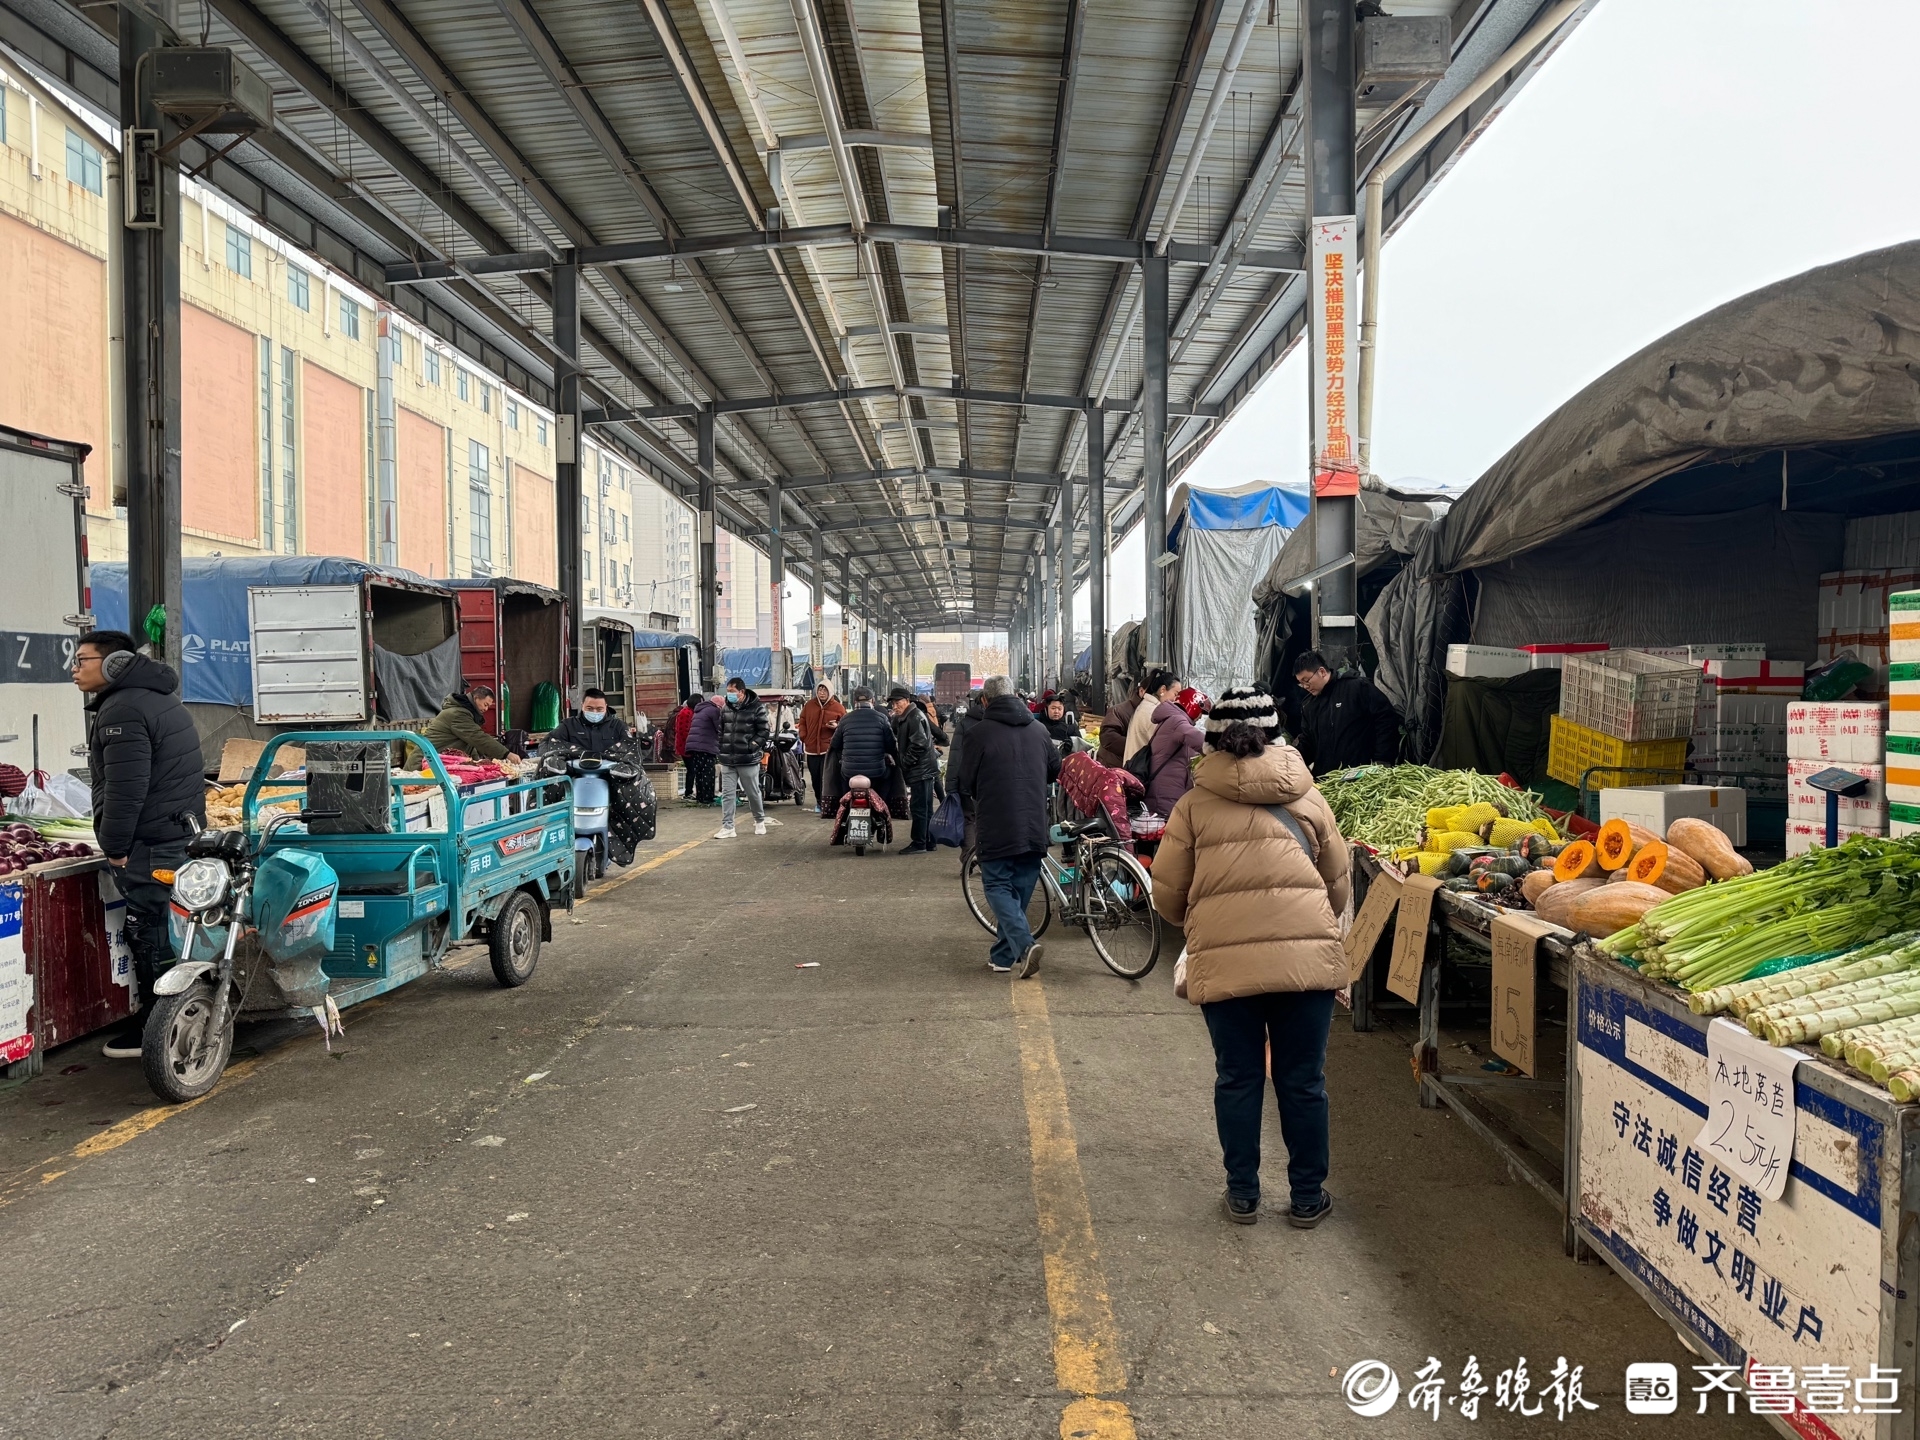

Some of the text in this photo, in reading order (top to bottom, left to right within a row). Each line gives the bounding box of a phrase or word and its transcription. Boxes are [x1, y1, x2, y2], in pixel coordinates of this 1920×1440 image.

[1324, 253, 1346, 460] 坚决摧毁黑恶势力经济基础
[16, 636, 31, 669] Z
[470, 854, 491, 874] 宗申
[1588, 1008, 1621, 1041] 价格公示
[1612, 1100, 1763, 1237] 守法诚信经营
[1638, 1263, 1715, 1342] 历城区市场监督管理局
[1652, 1186, 1824, 1343] 争做文明业户
